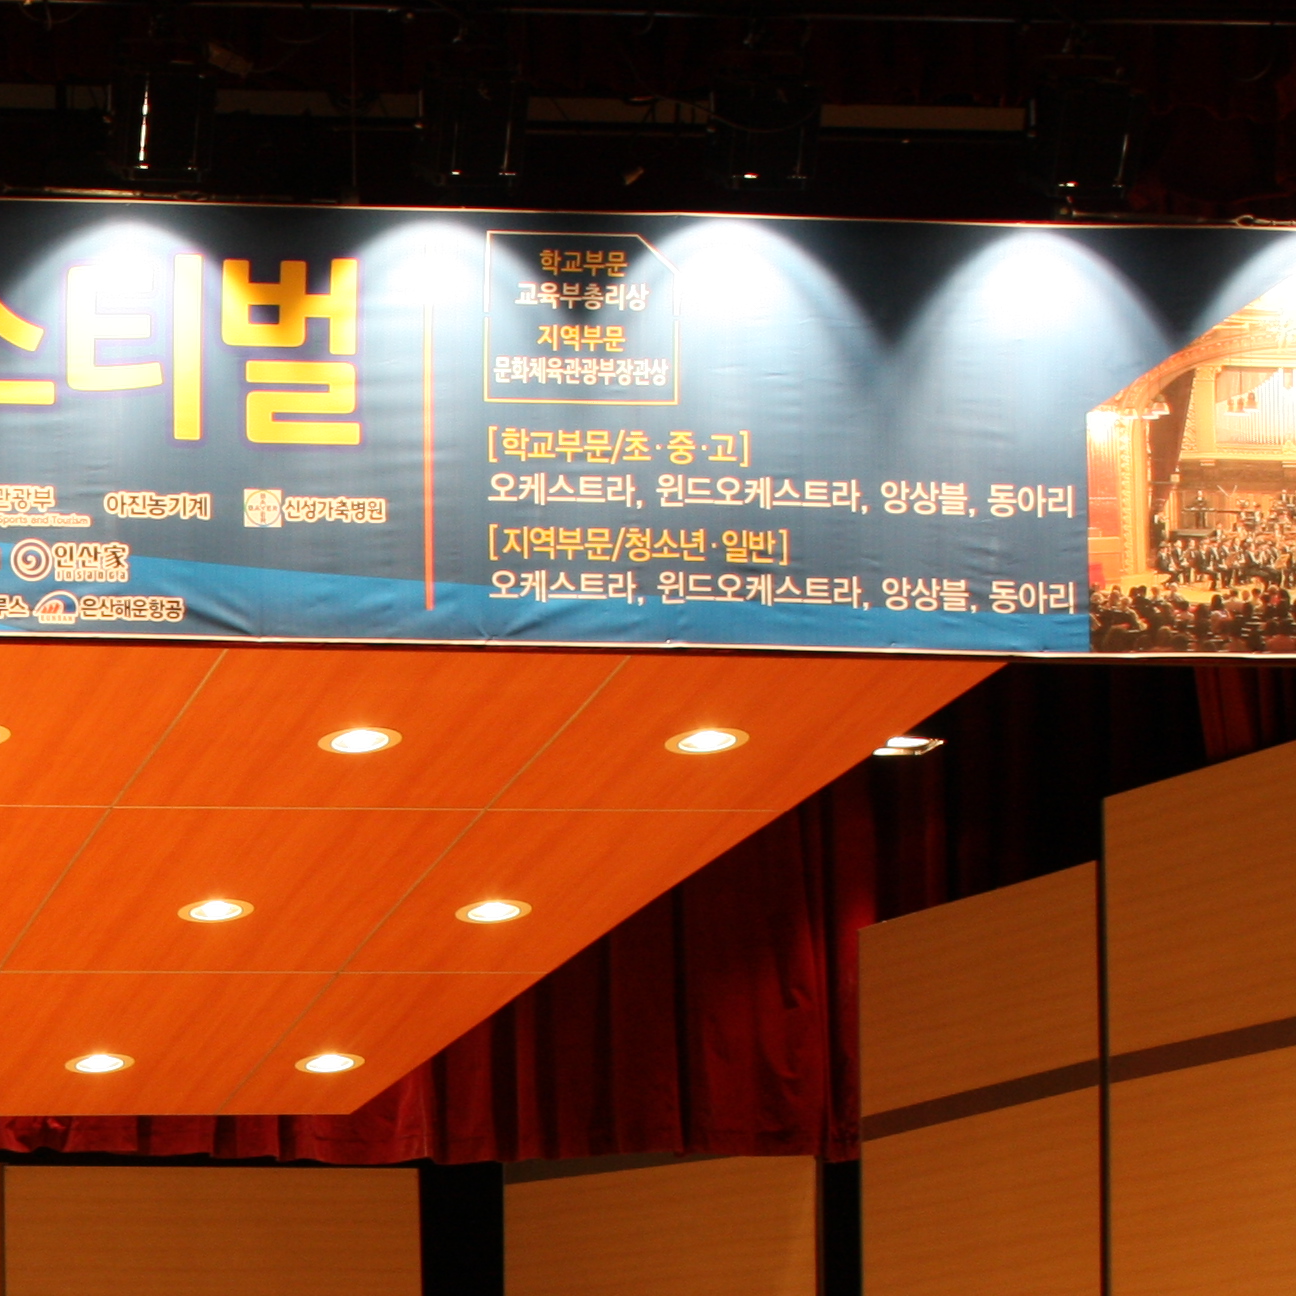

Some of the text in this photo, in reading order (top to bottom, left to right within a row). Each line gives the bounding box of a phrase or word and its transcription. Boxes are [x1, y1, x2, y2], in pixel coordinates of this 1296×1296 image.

[539, 249, 628, 278] 학교부문
[514, 282, 649, 312] 교육부총리상
[536, 324, 627, 352] 지역부문
[493, 355, 669, 387] 문화체육관광부장관상
[106, 493, 210, 518] 아진농기계
[487, 472, 1075, 519] 오케스트라, 윈드오케스트라, 앙상블, 동아리
[30, 516, 49, 525] and
[284, 498, 386, 523] 신성가축병원
[488, 569, 1076, 615] 오케스트라, 윈드오케스트라, 앙상블, 동아리
[80, 597, 184, 619] 은산해운항공
